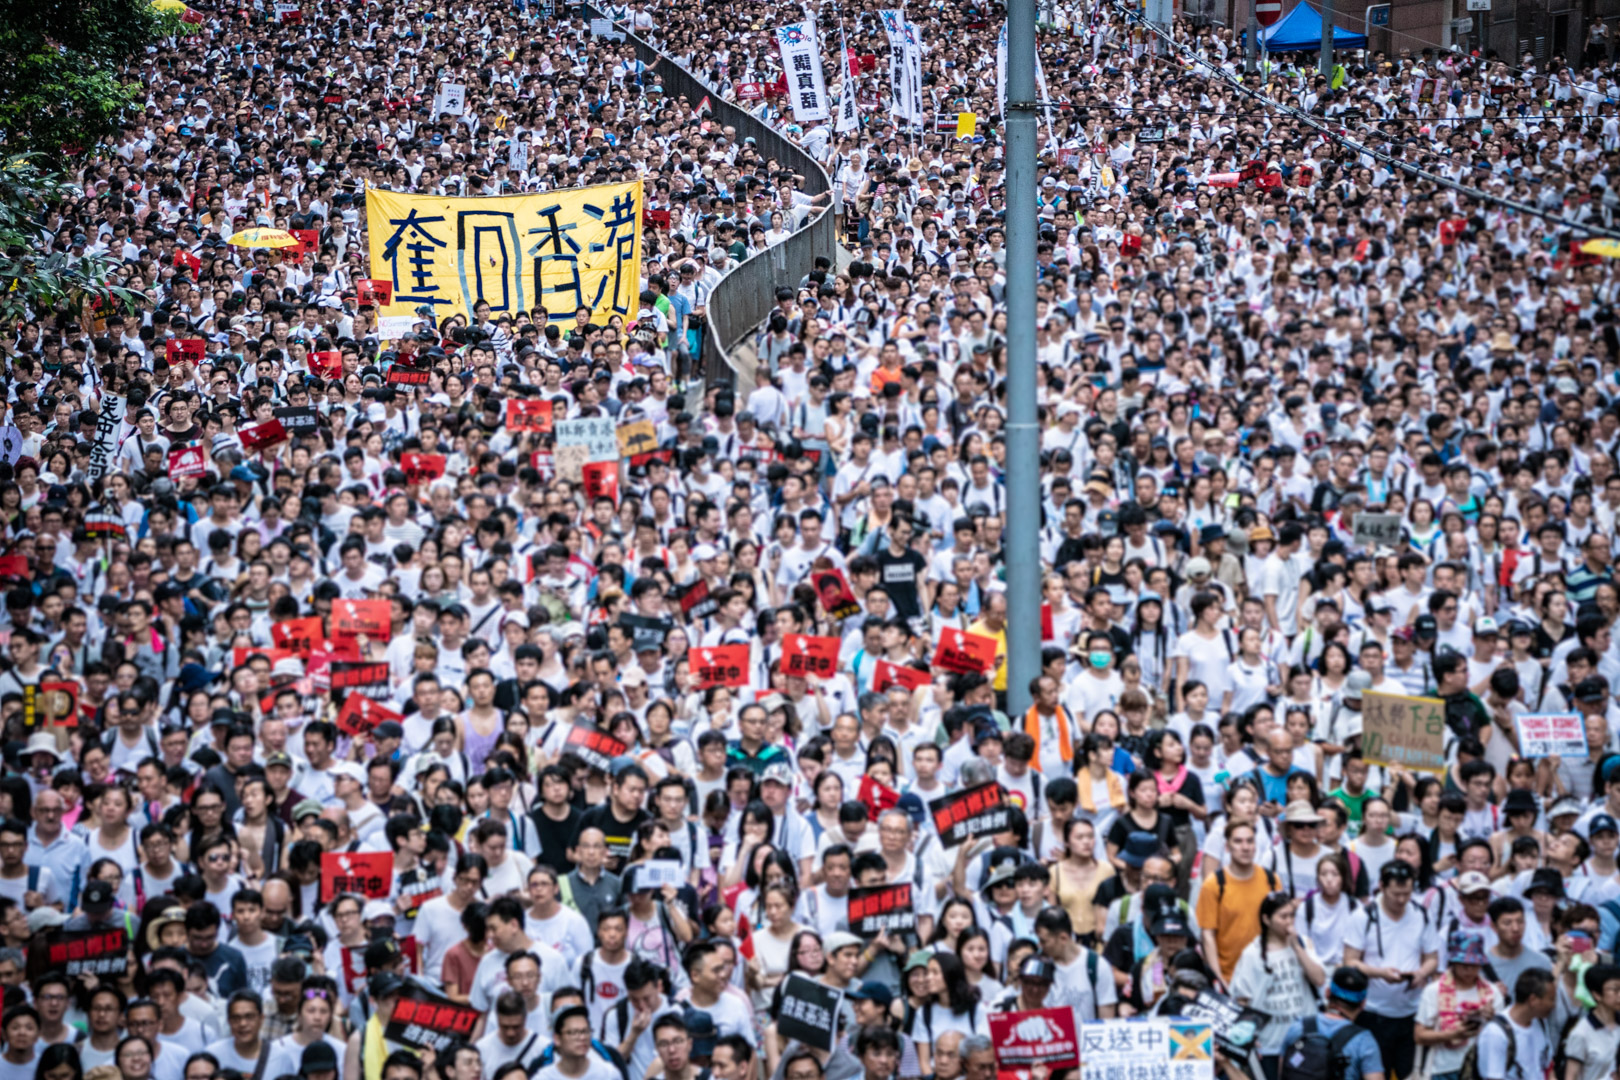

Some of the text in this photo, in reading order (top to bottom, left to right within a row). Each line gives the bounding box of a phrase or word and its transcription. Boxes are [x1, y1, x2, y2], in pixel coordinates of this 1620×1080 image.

[171, 351, 199, 362] 反送中
[790, 654, 830, 672] 反送中
[699, 666, 741, 682] 反送中
[333, 875, 383, 896] 反送中
[1082, 1026, 1163, 1053] 反送中
